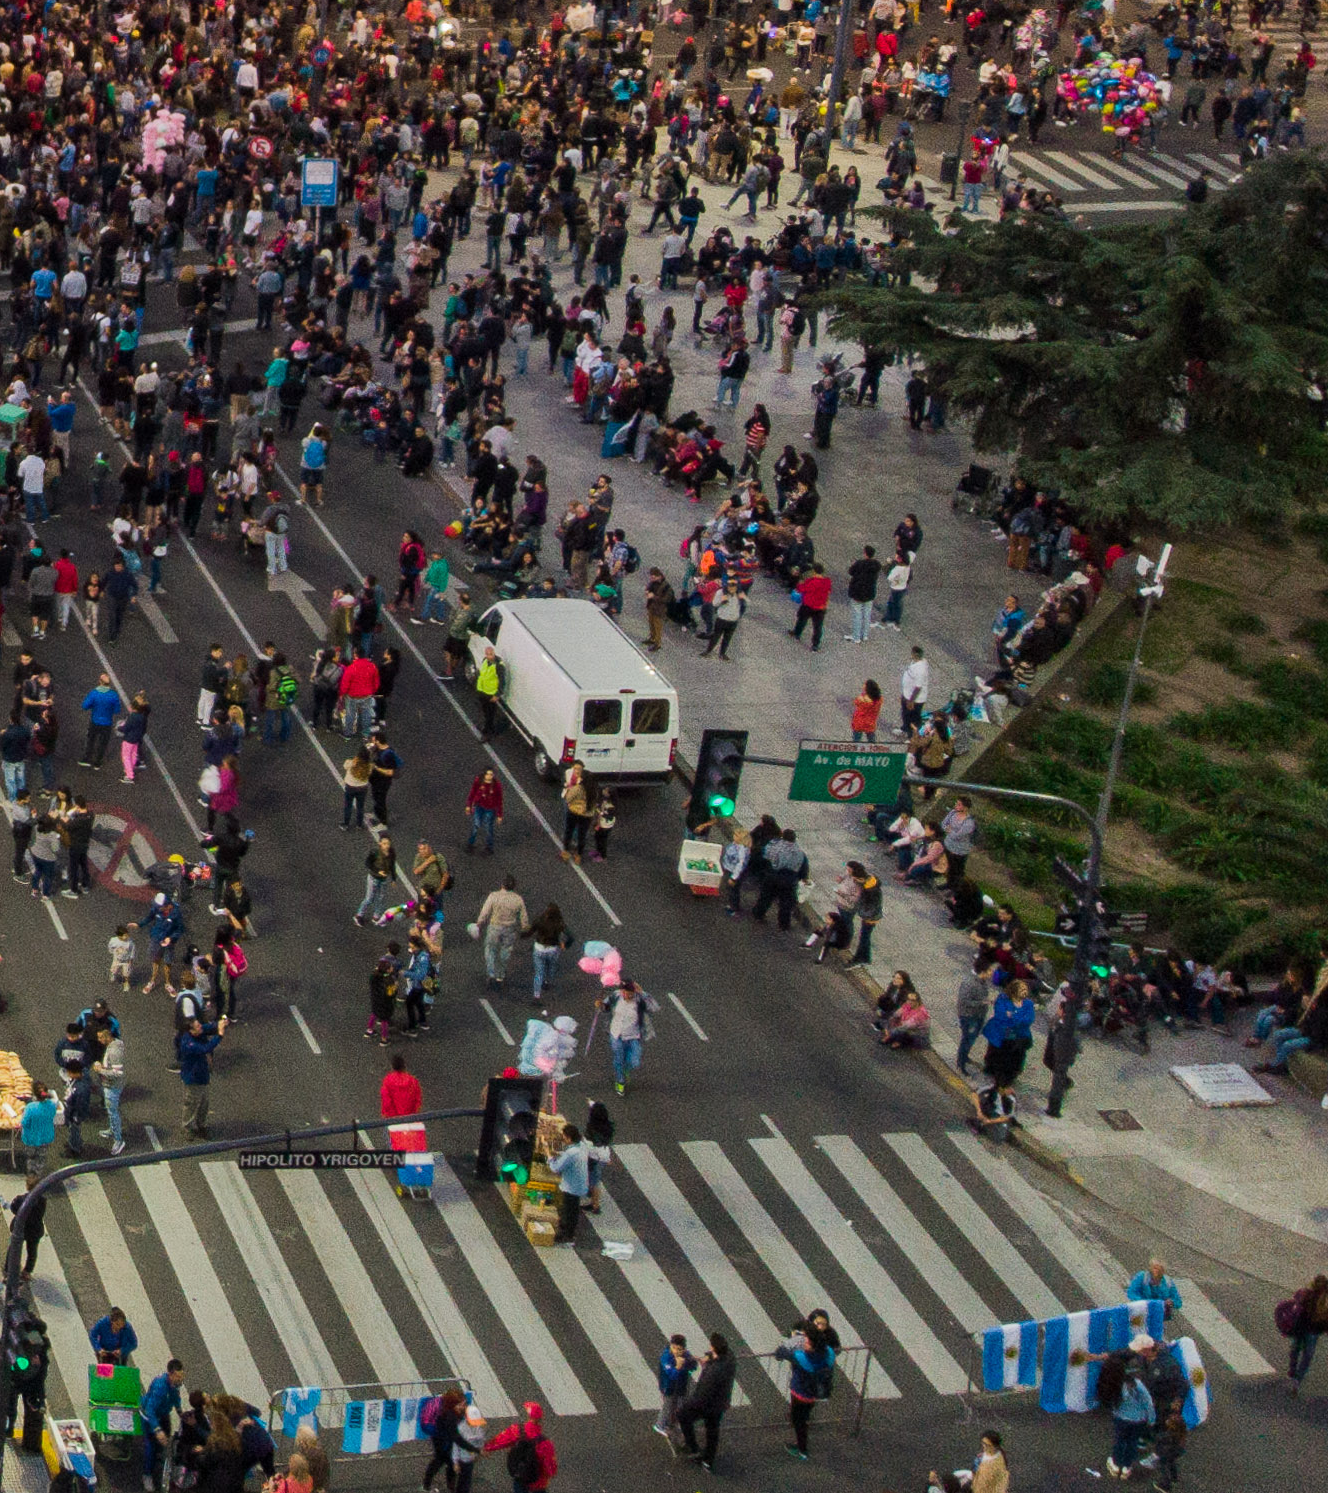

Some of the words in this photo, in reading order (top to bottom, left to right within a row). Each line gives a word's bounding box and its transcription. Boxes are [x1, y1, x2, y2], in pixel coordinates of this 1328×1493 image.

[836, 755, 851, 766] de
[854, 755, 890, 768] MAYO
[240, 1153, 316, 1168] HIPOLITO
[320, 1152, 405, 1167] YRIGOYEN
